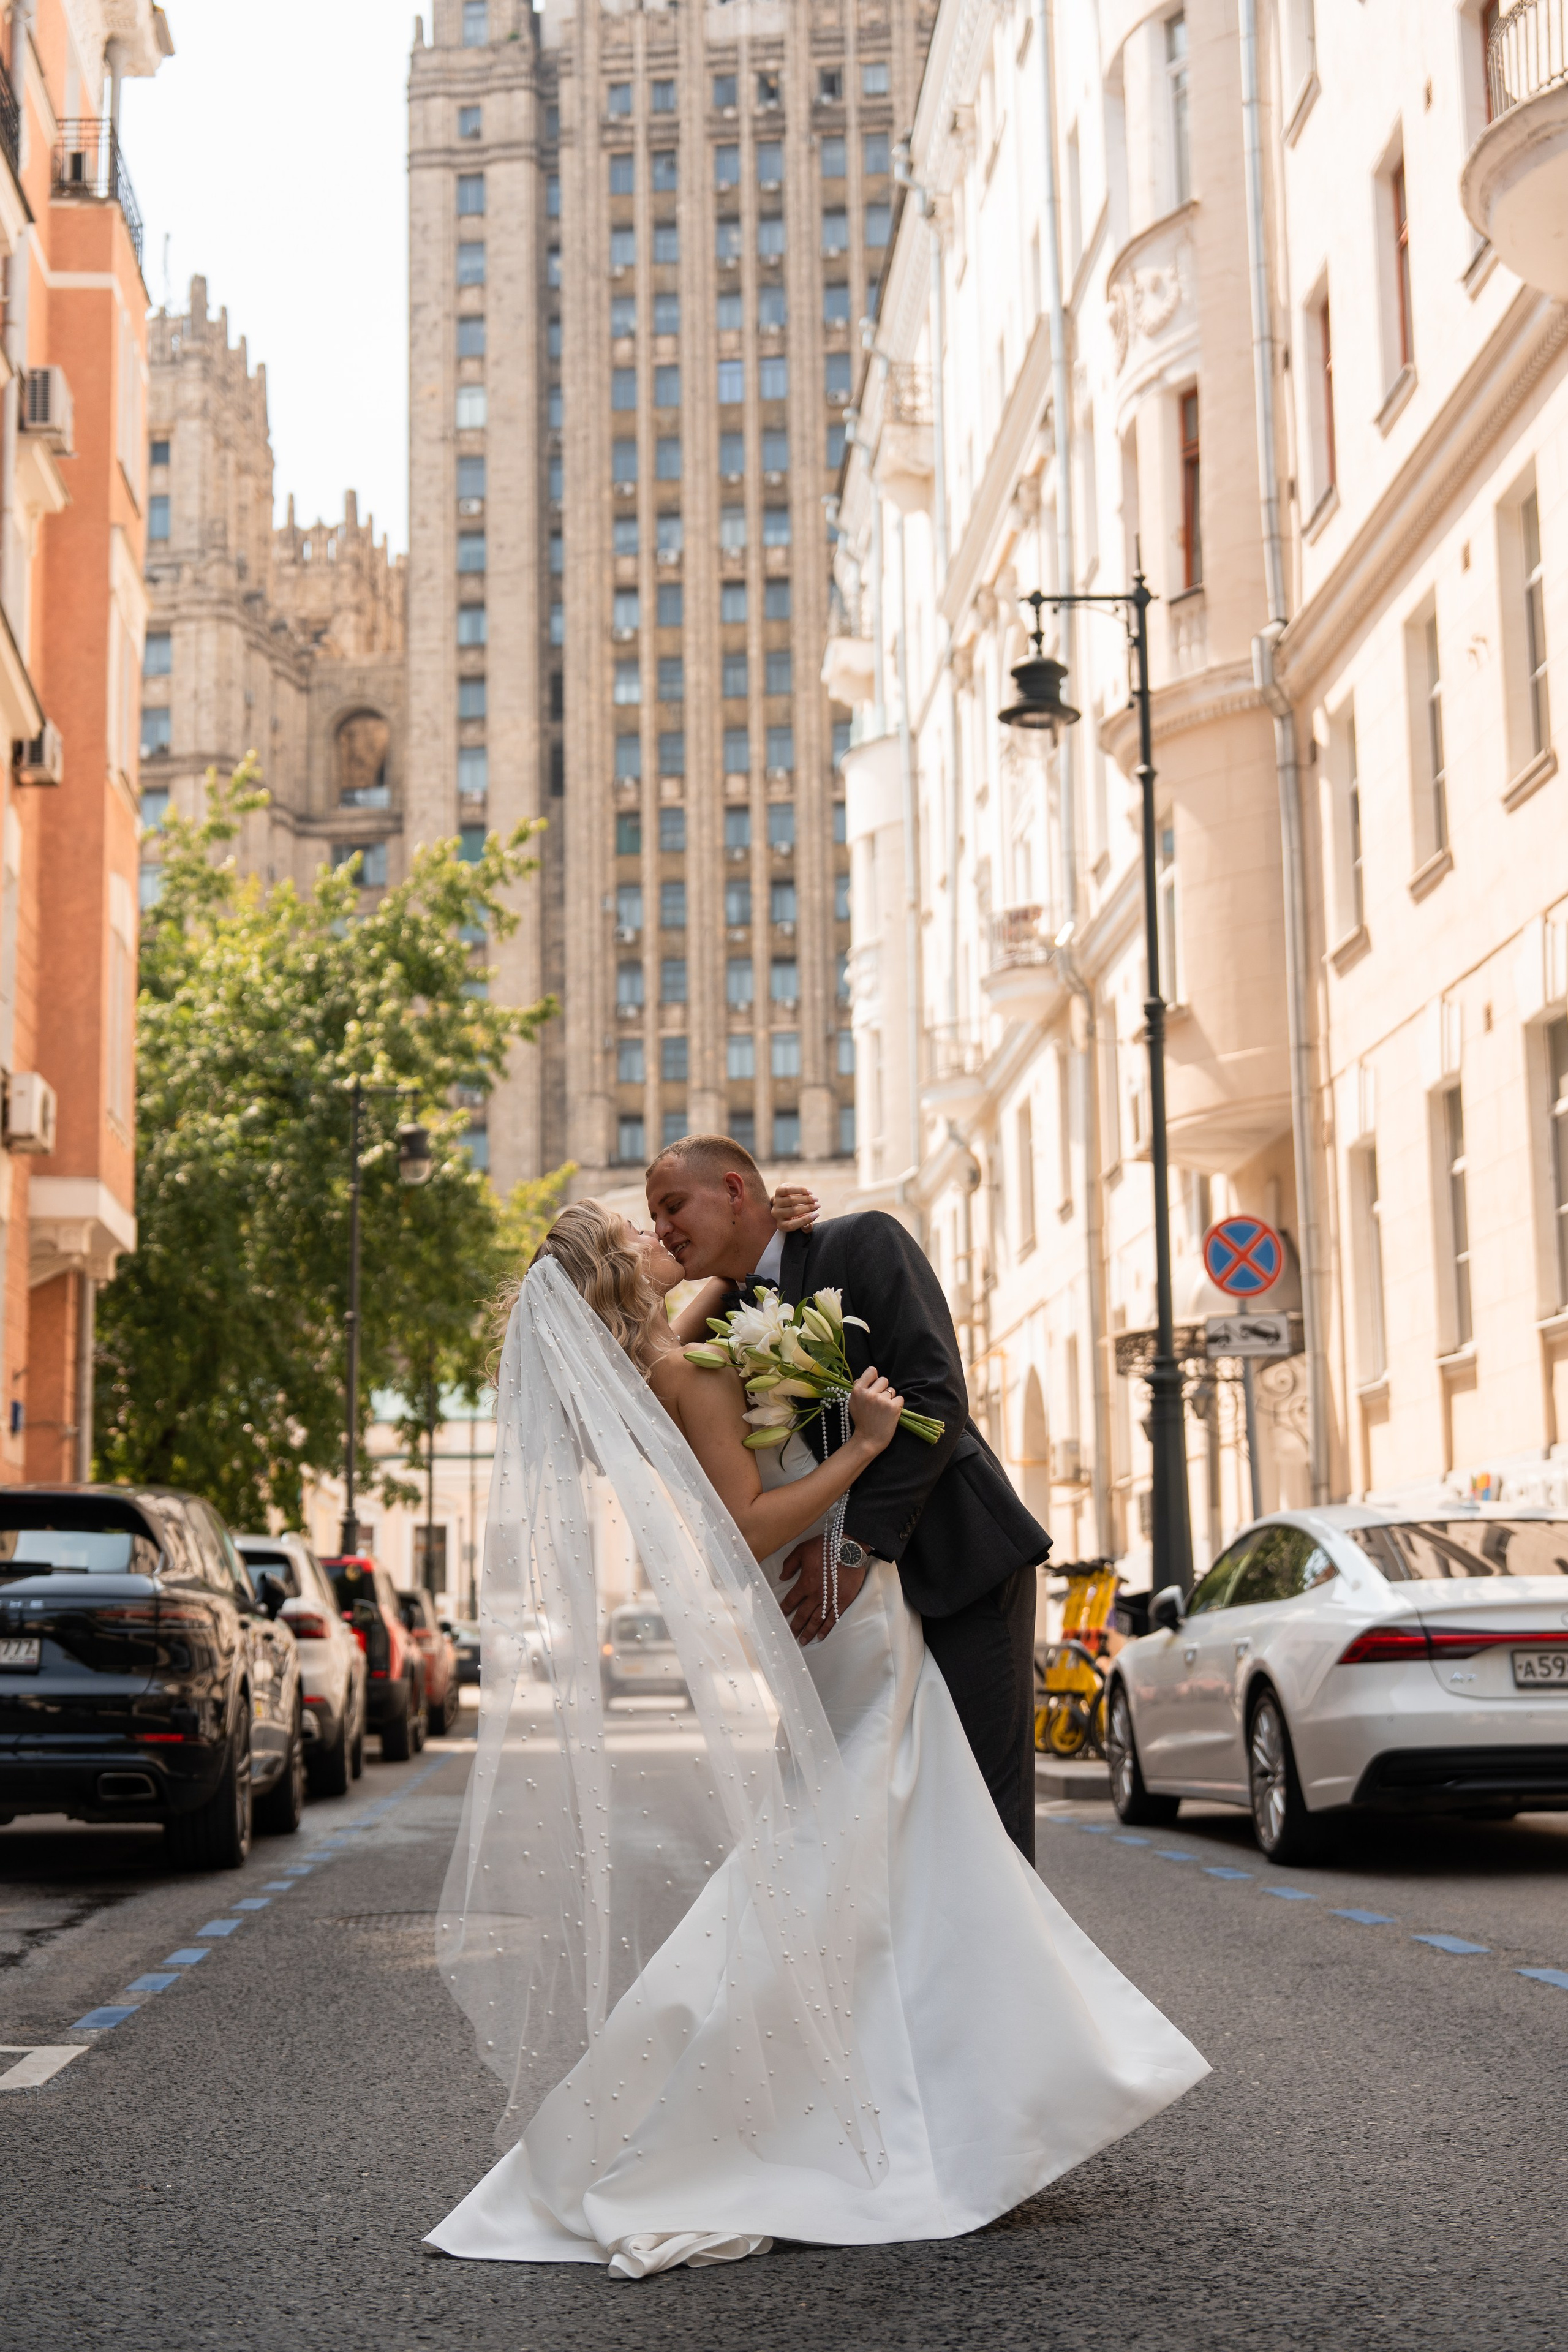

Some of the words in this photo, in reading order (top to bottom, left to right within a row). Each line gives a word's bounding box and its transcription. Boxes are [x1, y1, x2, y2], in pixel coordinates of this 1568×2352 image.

[0, 1600, 44, 1610] HE
[1, 1640, 33, 1656] 777
[1523, 1655, 1568, 1678] A59
[1450, 1672, 1477, 1683] A7
